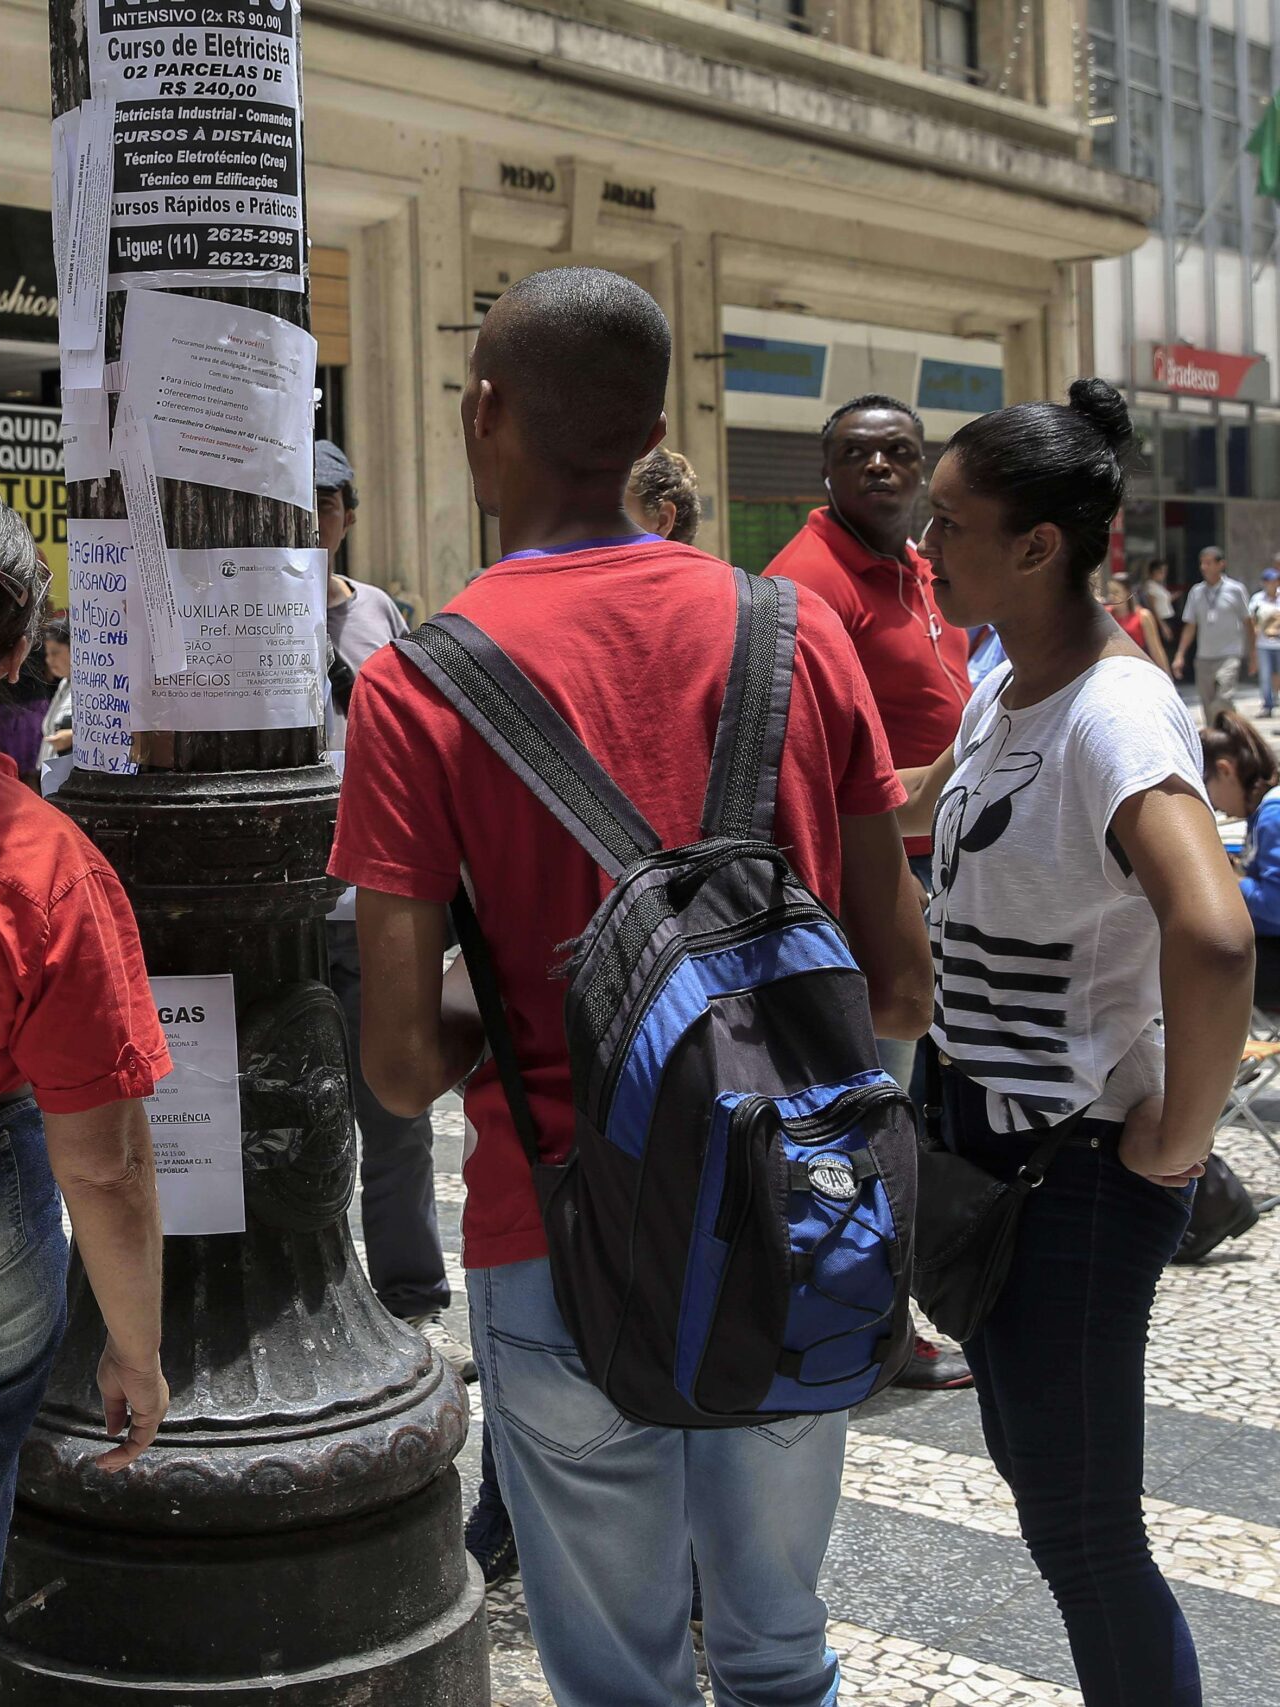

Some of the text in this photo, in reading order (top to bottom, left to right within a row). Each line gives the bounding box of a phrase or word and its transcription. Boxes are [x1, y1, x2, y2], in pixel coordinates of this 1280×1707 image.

[112, 8, 281, 33] INTENSIVO (2x R$ 90,00)
[108, 33, 290, 65] Curso de Eletricista
[123, 63, 282, 83] 02 PARCELAS DE
[159, 81, 257, 99] R$ 240,00
[114, 107, 174, 123] Eletricista
[178, 107, 236, 120] Industrial
[246, 108, 292, 128] Comandos
[114, 127, 293, 148] CURSOS À DISTÂNCIA
[124, 150, 287, 171] Técnico Eletrotécnico (Crea)
[140, 172, 278, 189] Técnico em Edificações
[111, 195, 297, 219] ursos Rápidos e Práticos
[117, 227, 293, 261] Ligue: (11) 2625-2995
[207, 251, 293, 269] 2623-7326
[1167, 358, 1219, 392] Bradesco
[166, 376, 182, 385] Para
[203, 383, 234, 395] Imediato
[163, 388, 249, 411] Oferecemos treinamento
[161, 401, 244, 423] Oferecemos ajuda custo
[168, 417, 204, 429] conselheiro
[178, 446, 199, 455] Temos
[199, 450, 221, 459] apenas
[227, 456, 245, 464] vagas
[244, 603, 263, 617] DE
[267, 602, 310, 617] LIMPEZA
[200, 623, 293, 636] Pref. Masculino
[259, 654, 273, 668] R$
[154, 672, 230, 687] BENEFÍCIOS
[168, 689, 188, 697] Barão
[191, 689, 201, 697] de
[150, 1112, 211, 1124] EXPERIÊNCIA
[820, 1167, 849, 1188] BAG
